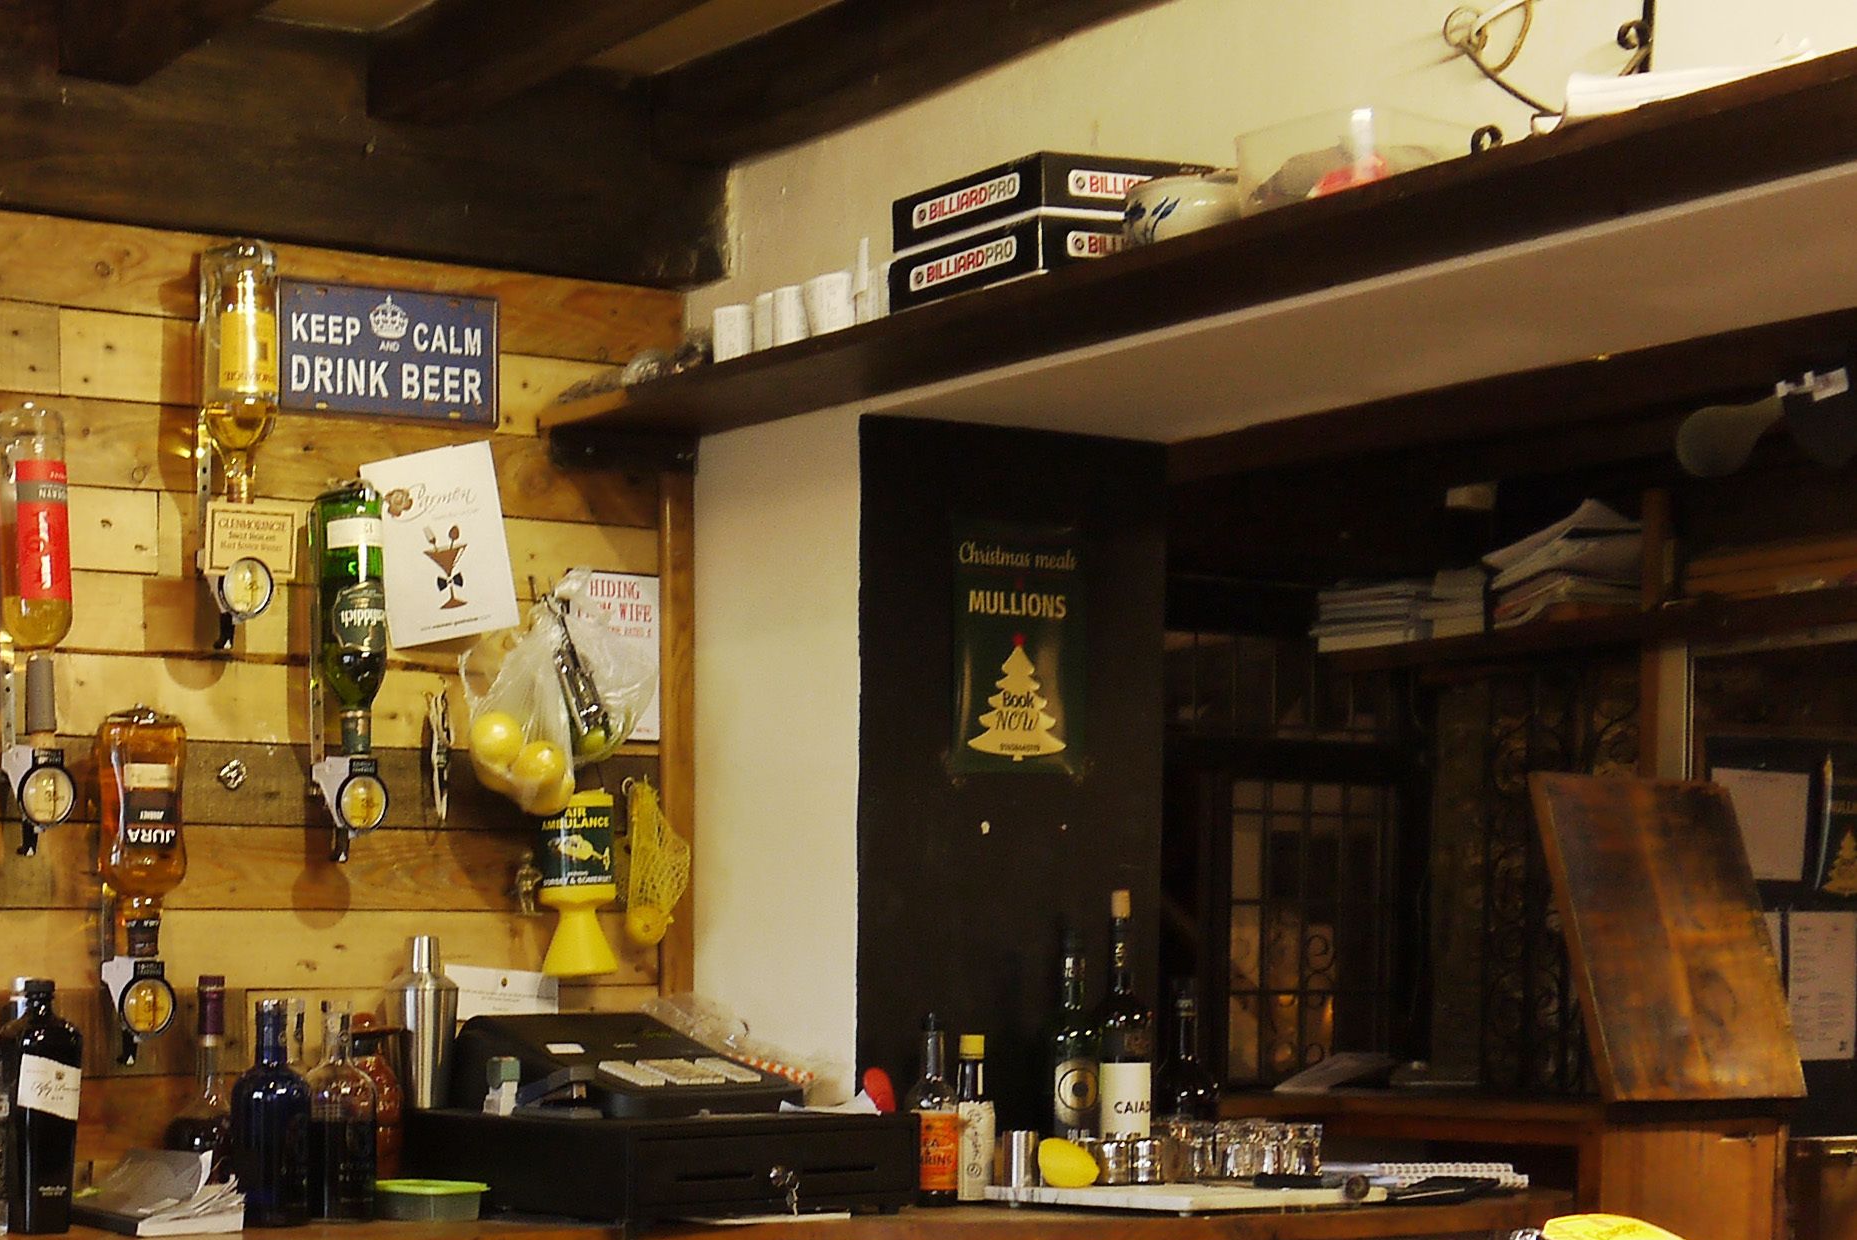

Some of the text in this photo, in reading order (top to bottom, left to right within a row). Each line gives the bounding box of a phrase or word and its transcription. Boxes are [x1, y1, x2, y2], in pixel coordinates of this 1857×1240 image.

[929, 178, 1016, 221] BILLIARDPRO
[925, 248, 1014, 284] BILLIARDPRO
[291, 312, 482, 358] KEEP CALM
[379, 341, 400, 353] AND
[291, 354, 483, 406] DRINK BEER
[958, 540, 1032, 569] Christmas
[590, 579, 641, 600] HIDING
[618, 603, 653, 624] WIFE
[968, 589, 1067, 620] MULLIONS
[1002, 690, 1035, 709] Book
[995, 710, 1040, 732] NOW
[564, 807, 587, 818] AIR
[542, 816, 610, 831] AMBULANCE
[127, 828, 176, 844] JURA
